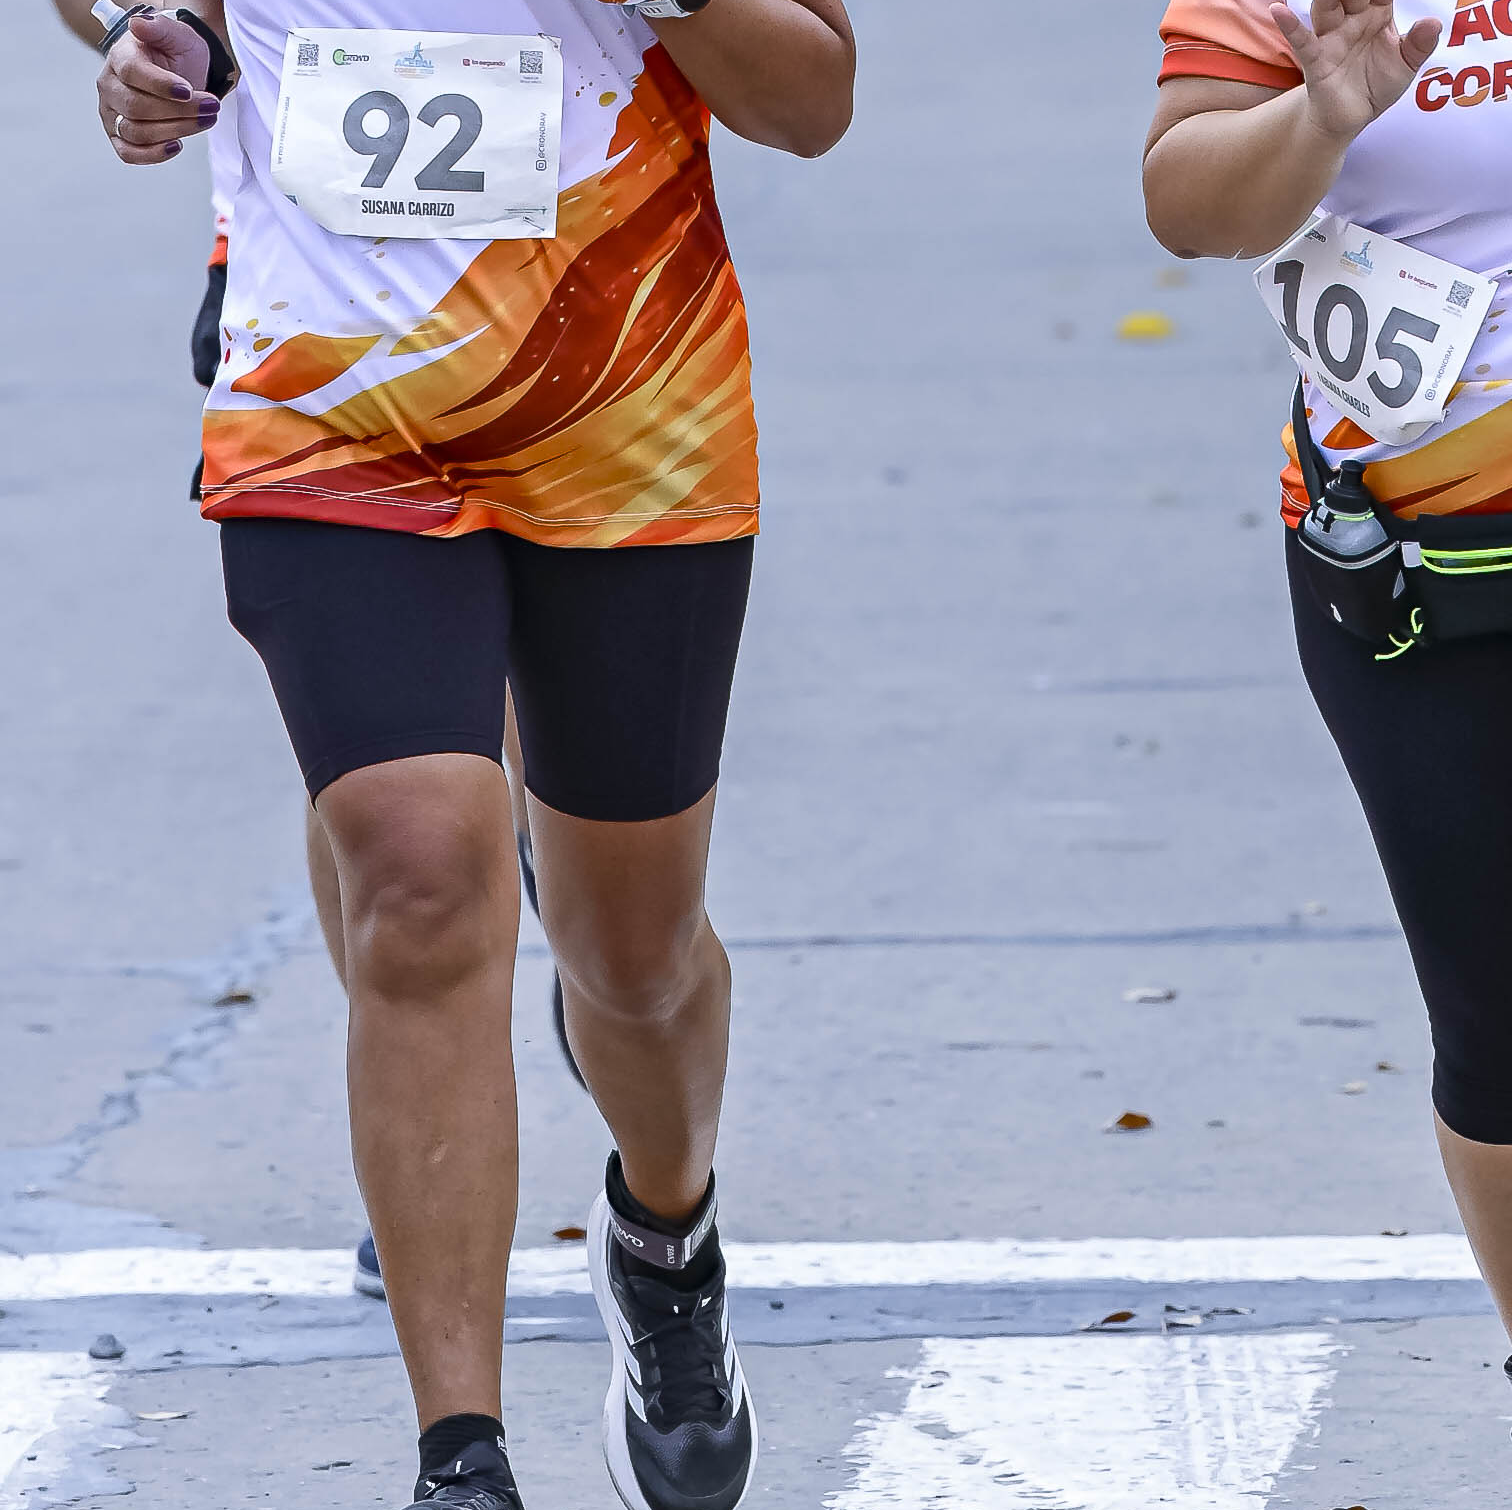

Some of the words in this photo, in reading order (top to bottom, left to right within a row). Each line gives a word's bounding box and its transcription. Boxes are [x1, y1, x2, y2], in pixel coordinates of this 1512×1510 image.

[342, 90, 485, 193] 92
[361, 199, 406, 216] SUSANA
[408, 201, 455, 218] CARRIZO
[1273, 259, 1441, 409] 105
[1341, 387, 1371, 418] CHARLES
